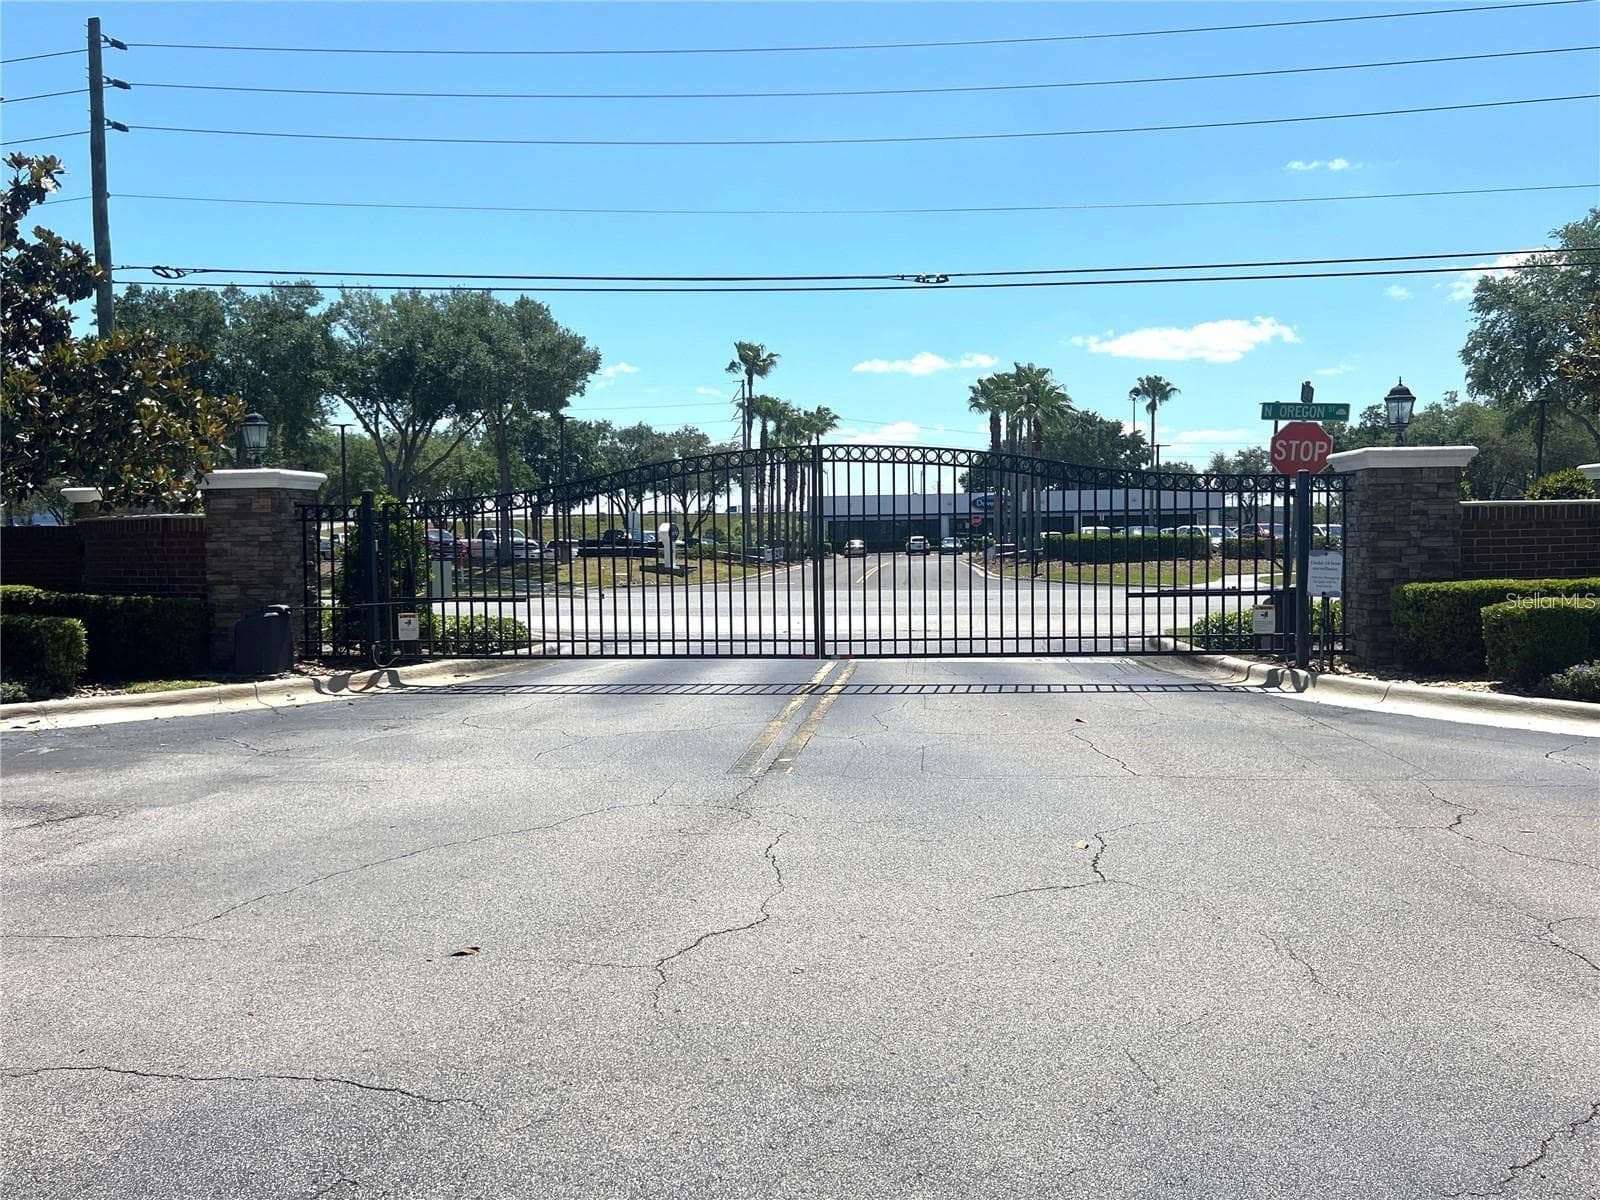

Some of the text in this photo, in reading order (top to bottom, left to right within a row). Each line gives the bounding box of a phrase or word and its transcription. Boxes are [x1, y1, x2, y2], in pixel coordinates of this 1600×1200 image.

[1264, 405, 1272, 417] N
[1280, 405, 1325, 418] OREGON
[1274, 440, 1328, 462] STOP
